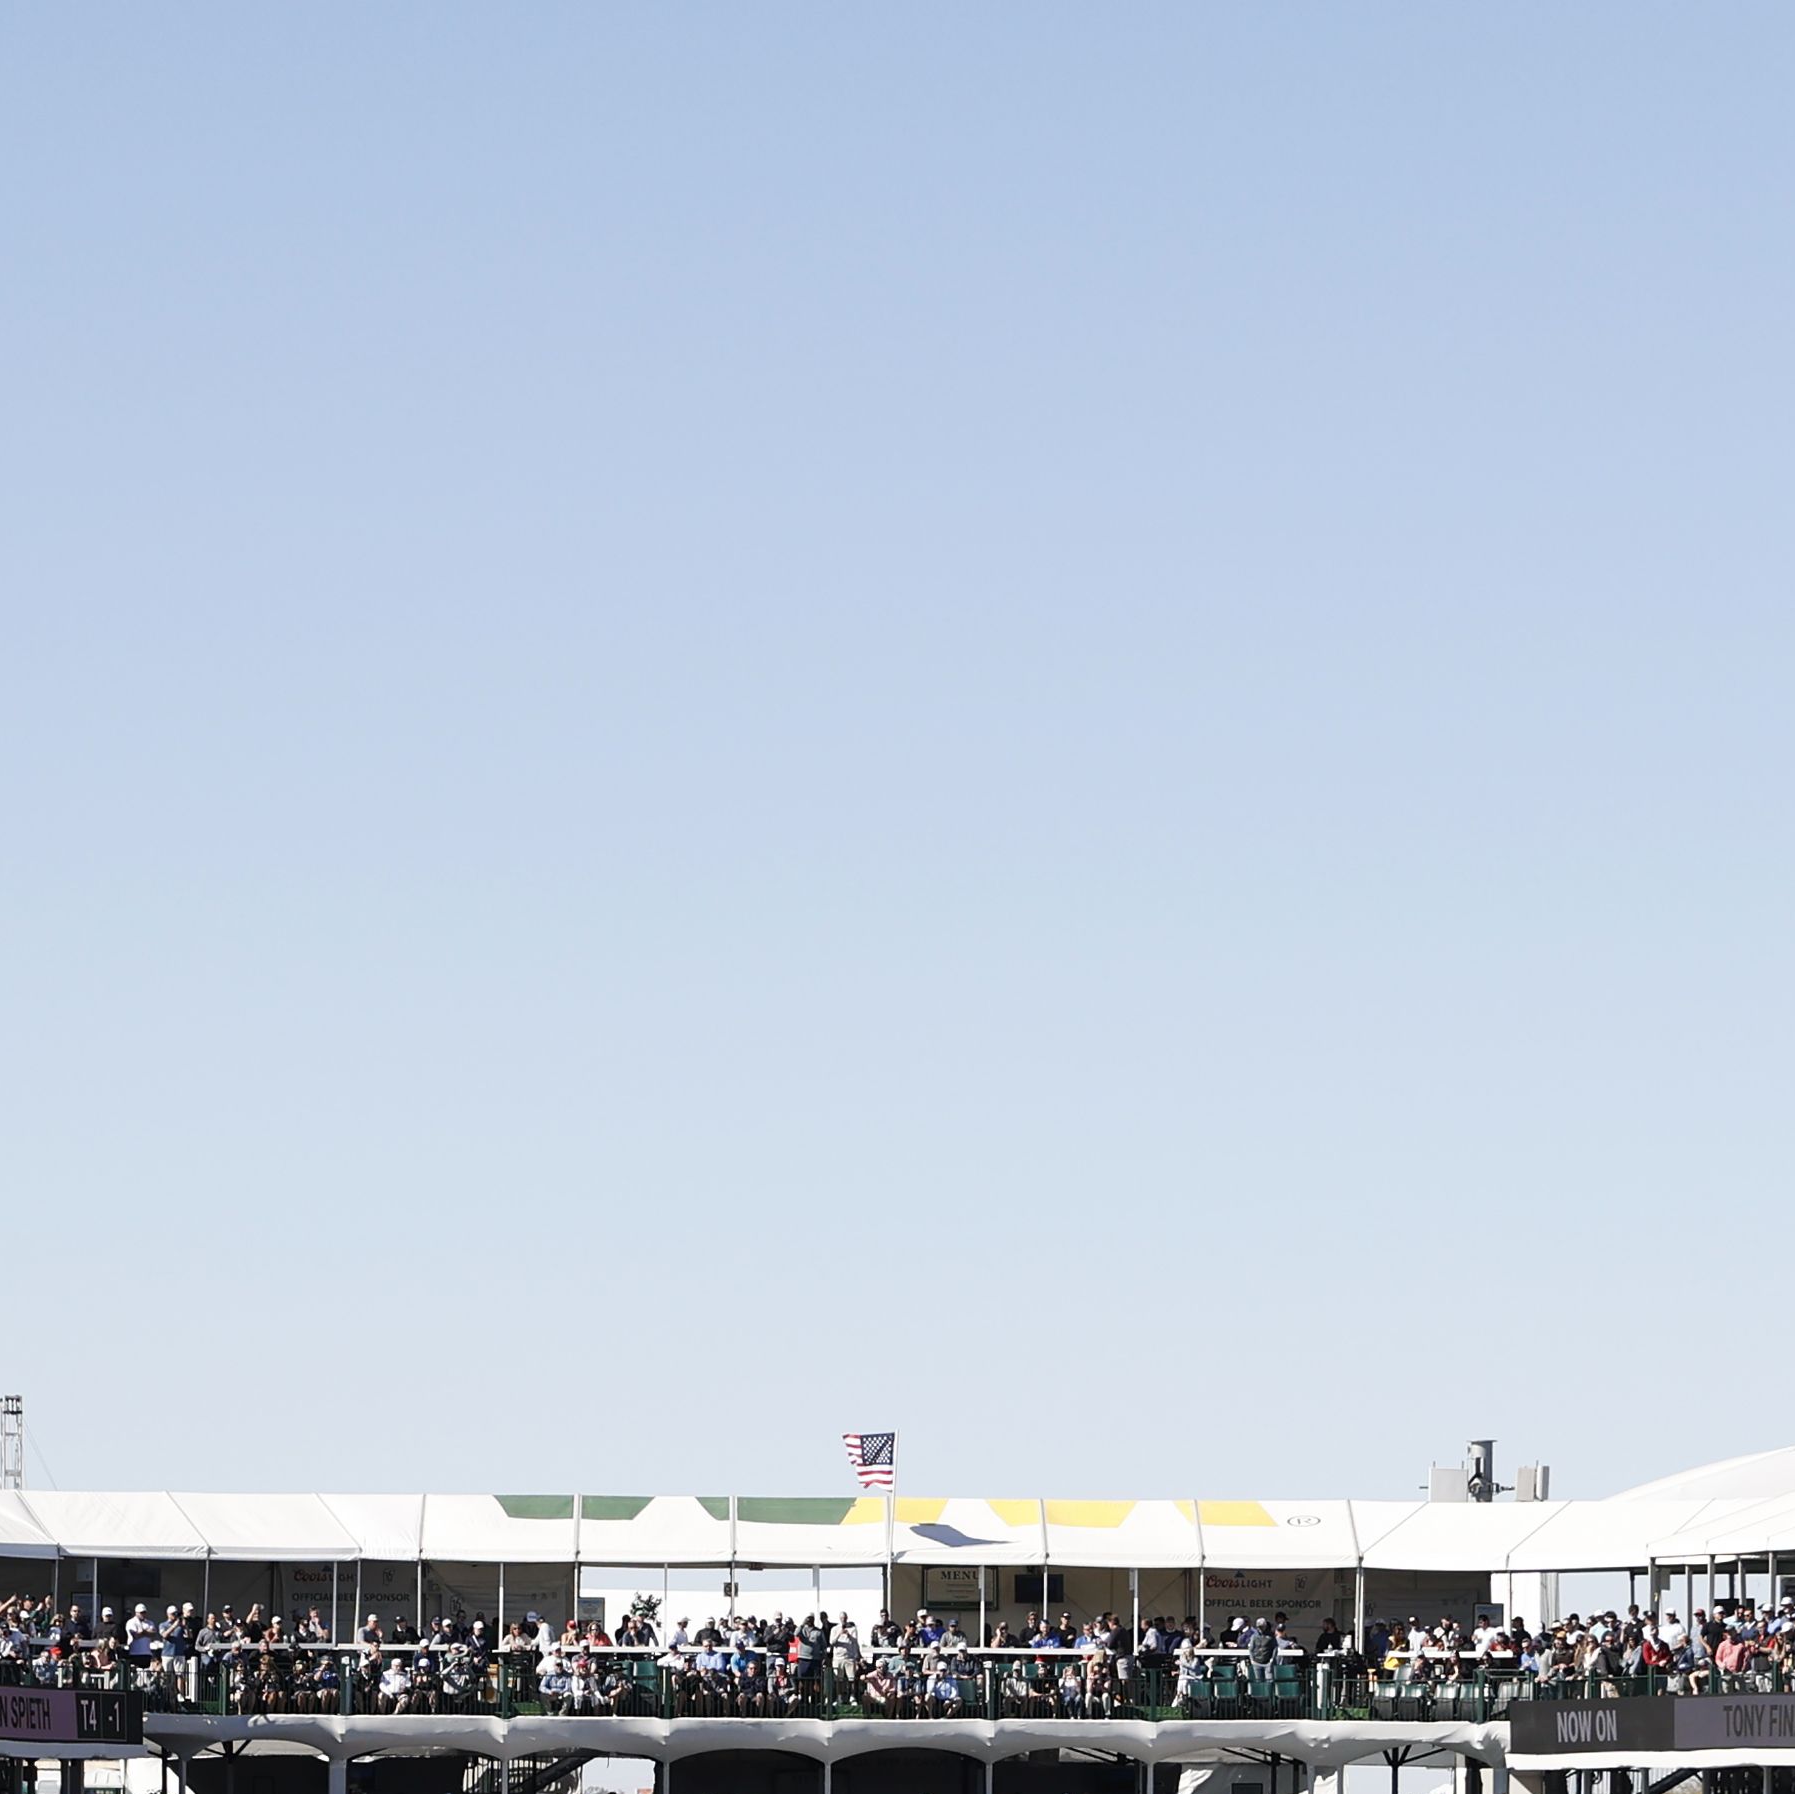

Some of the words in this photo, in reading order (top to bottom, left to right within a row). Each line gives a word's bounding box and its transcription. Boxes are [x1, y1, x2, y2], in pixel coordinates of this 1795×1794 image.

[363, 1593, 410, 1602] SPONSOR
[1206, 1574, 1241, 1588] Coors
[1242, 1579, 1273, 1588] LIGHT
[1204, 1599, 1247, 1608] OFFICIAL
[1250, 1599, 1273, 1608] BEER
[1276, 1599, 1321, 1609] SPONSOR
[10, 1695, 52, 1731] SPIETH
[80, 1699, 97, 1732] T4
[108, 1702, 120, 1732] -1
[1557, 1711, 1591, 1744] NOW
[1596, 1709, 1618, 1742] ON
[1723, 1705, 1764, 1738] TONY
